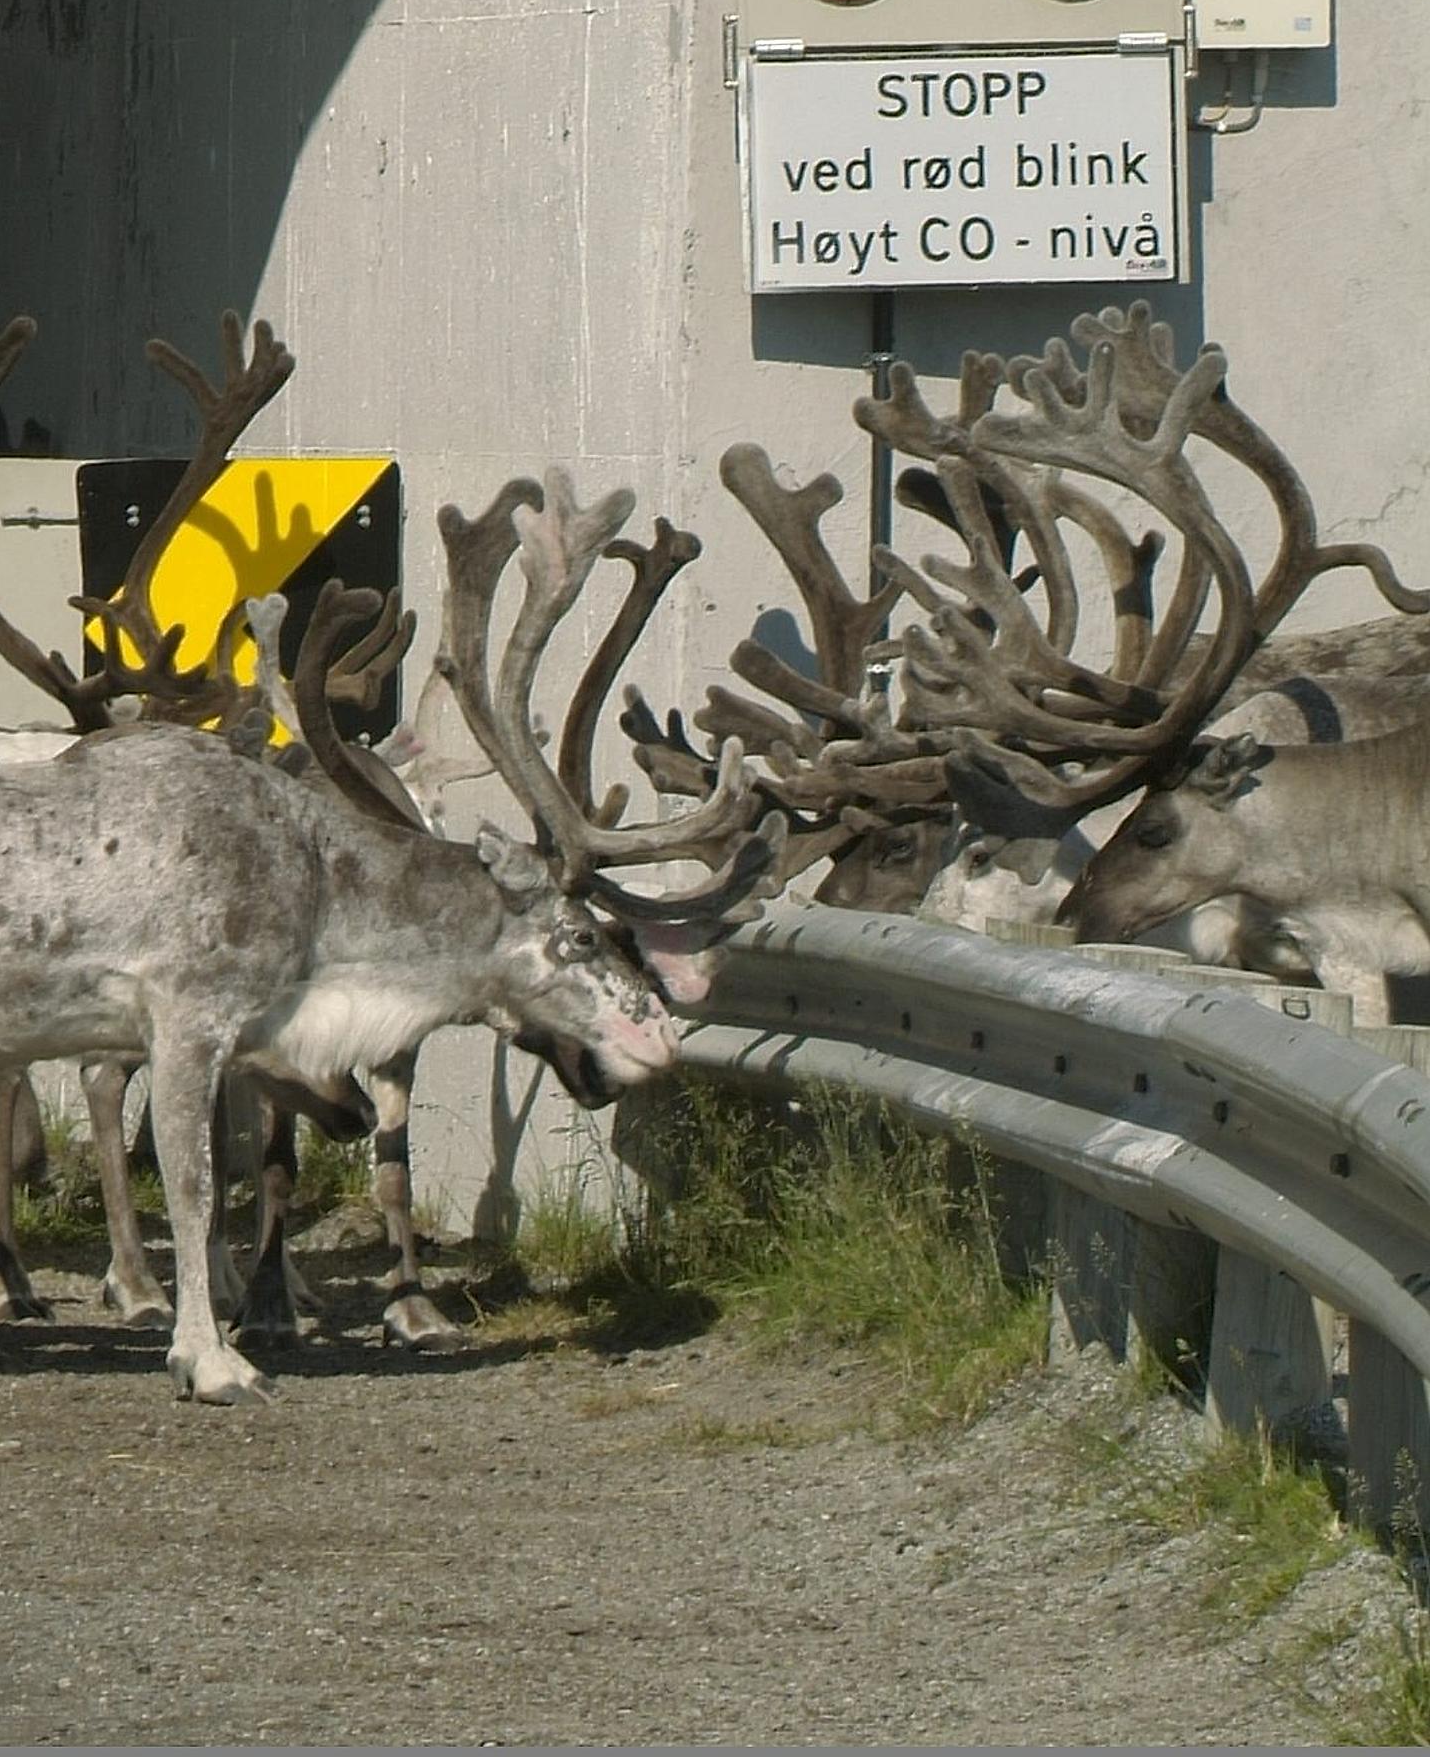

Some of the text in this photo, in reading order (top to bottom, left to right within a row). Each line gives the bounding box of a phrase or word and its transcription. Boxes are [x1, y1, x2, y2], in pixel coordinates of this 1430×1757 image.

[877, 70, 1047, 119] STOPP
[782, 140, 1150, 193] ved rød blink
[770, 219, 900, 276] Høyt
[919, 216, 995, 262] CO
[1049, 211, 1162, 260] nivå
